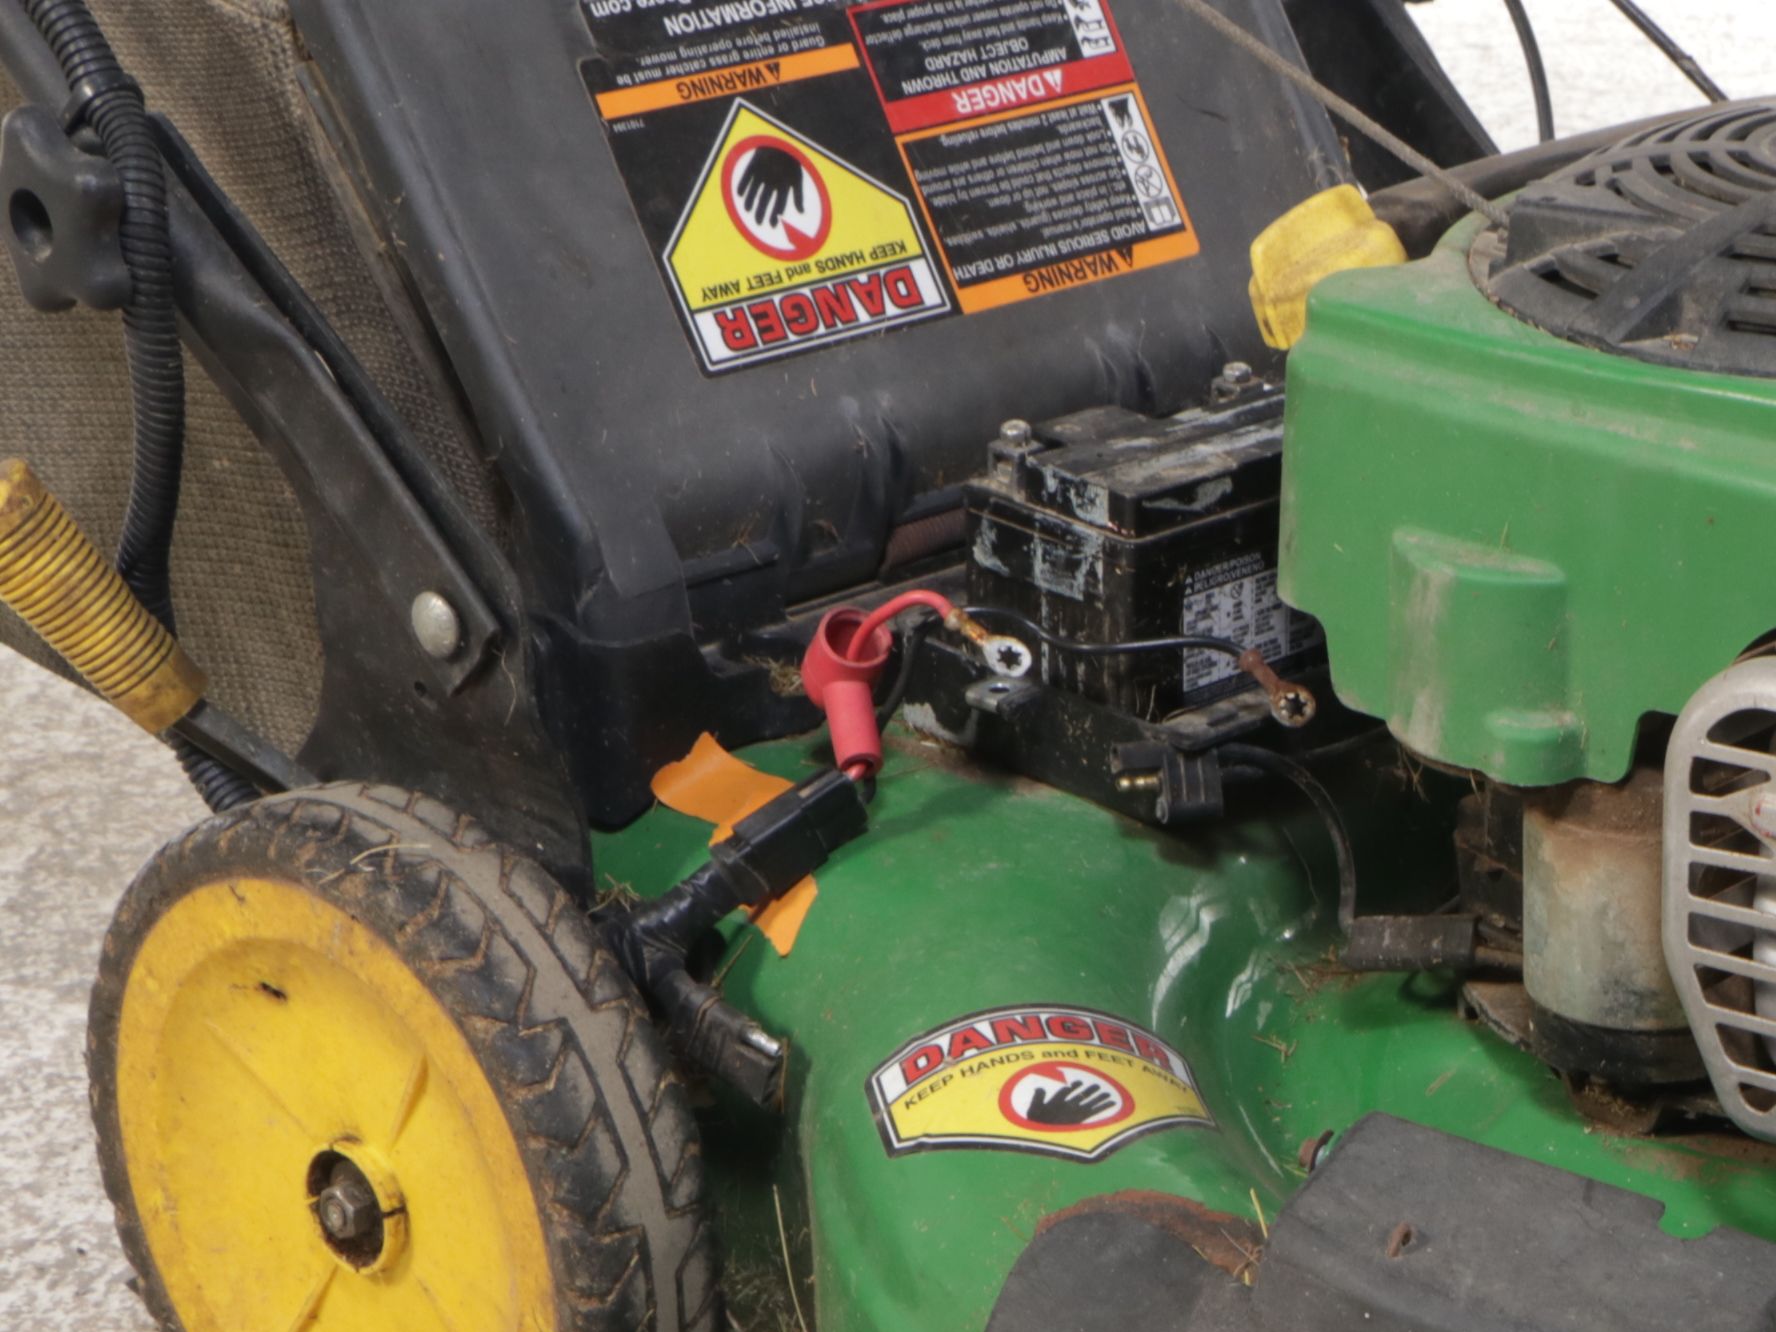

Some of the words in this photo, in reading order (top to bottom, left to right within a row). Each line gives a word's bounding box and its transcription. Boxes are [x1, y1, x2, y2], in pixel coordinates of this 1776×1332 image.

[663, 0, 797, 36] INFORMATION
[734, 30, 771, 48] before
[772, 20, 820, 40] installed
[678, 36, 733, 59] operating
[742, 45, 776, 61] entire
[776, 42, 789, 53] or
[790, 34, 826, 52] Guard
[977, 36, 1029, 59] OBJECT
[634, 48, 677, 66] mower.
[664, 57, 708, 77] catcher
[707, 49, 741, 66] grass
[922, 47, 978, 71] HAZARD
[988, 46, 1069, 75] AMPUTATION
[614, 72, 632, 86] be
[632, 67, 663, 82] must
[674, 65, 767, 100] WARNING
[900, 70, 960, 94] THROWN
[958, 64, 989, 81] AND
[950, 73, 1046, 113] DANGER
[1108, 218, 1148, 241] AVOID
[866, 239, 908, 261] KEEP
[1056, 228, 1111, 255] SERIOUS
[813, 249, 866, 273] HANDS
[993, 253, 1015, 271] OR
[1013, 241, 1058, 266] INJURY
[744, 270, 783, 290] FEET
[785, 263, 813, 280] and
[952, 258, 996, 281] DEATH
[1021, 251, 1120, 294] WARNING
[698, 279, 742, 300] AWAY
[711, 264, 925, 354] DANGER
[899, 1014, 1176, 1086] DANGER
[903, 1073, 955, 1111] KEEP
[959, 1049, 1035, 1079] HANDS
[1041, 1047, 1079, 1060] and
[1085, 1049, 1136, 1069] FEET
[1141, 1064, 1190, 1095] AWAY
